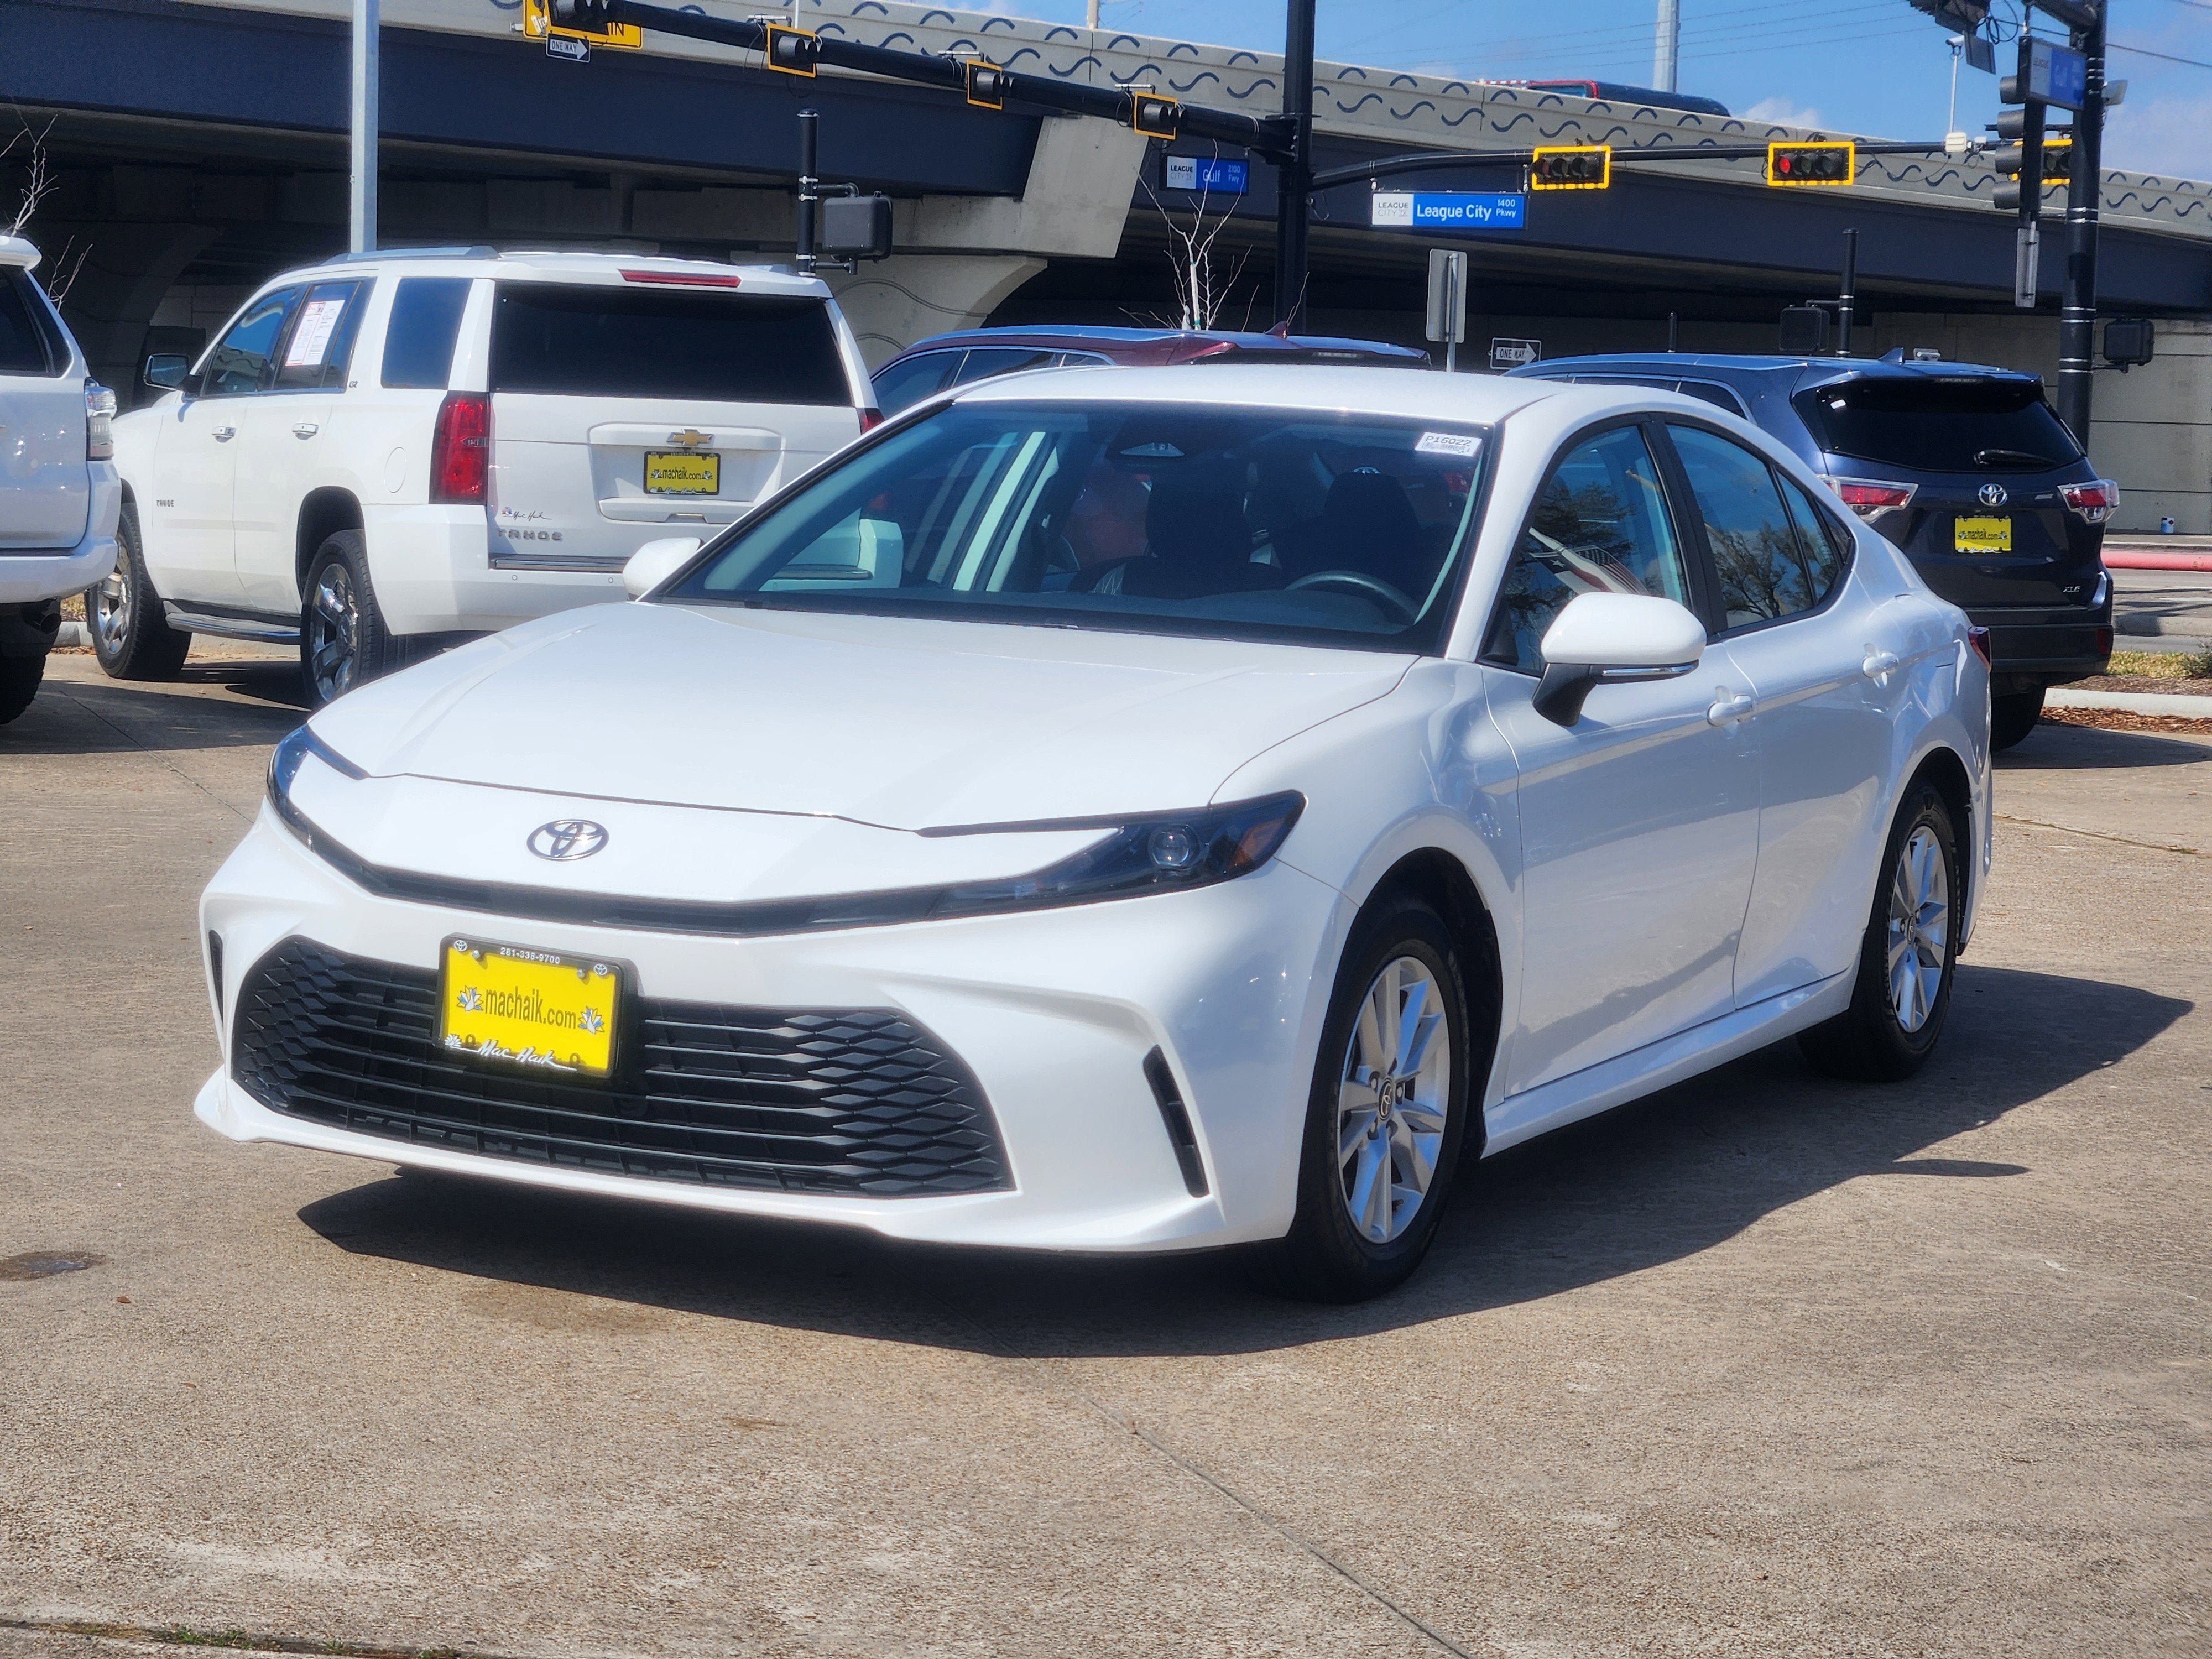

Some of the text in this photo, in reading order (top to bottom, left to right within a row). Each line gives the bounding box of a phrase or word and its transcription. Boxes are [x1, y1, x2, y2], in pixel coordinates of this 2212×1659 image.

[552, 40, 577, 53] ONE WAY
[1228, 164, 1240, 173] 2100
[1202, 169, 1220, 182] Gulf
[1228, 174, 1239, 184] Fwy
[1497, 199, 1516, 207] 1400
[1416, 204, 1492, 221] League City
[1496, 208, 1516, 218] Pkwy
[1500, 348, 1526, 359] ONE WAY
[1426, 436, 1472, 446] P15022
[662, 467, 701, 479] machaik.com
[498, 528, 563, 541] TAHOE
[500, 947, 560, 964] 281-338-9700
[485, 986, 576, 1029] machaik.com
[477, 1038, 515, 1058] Mac
